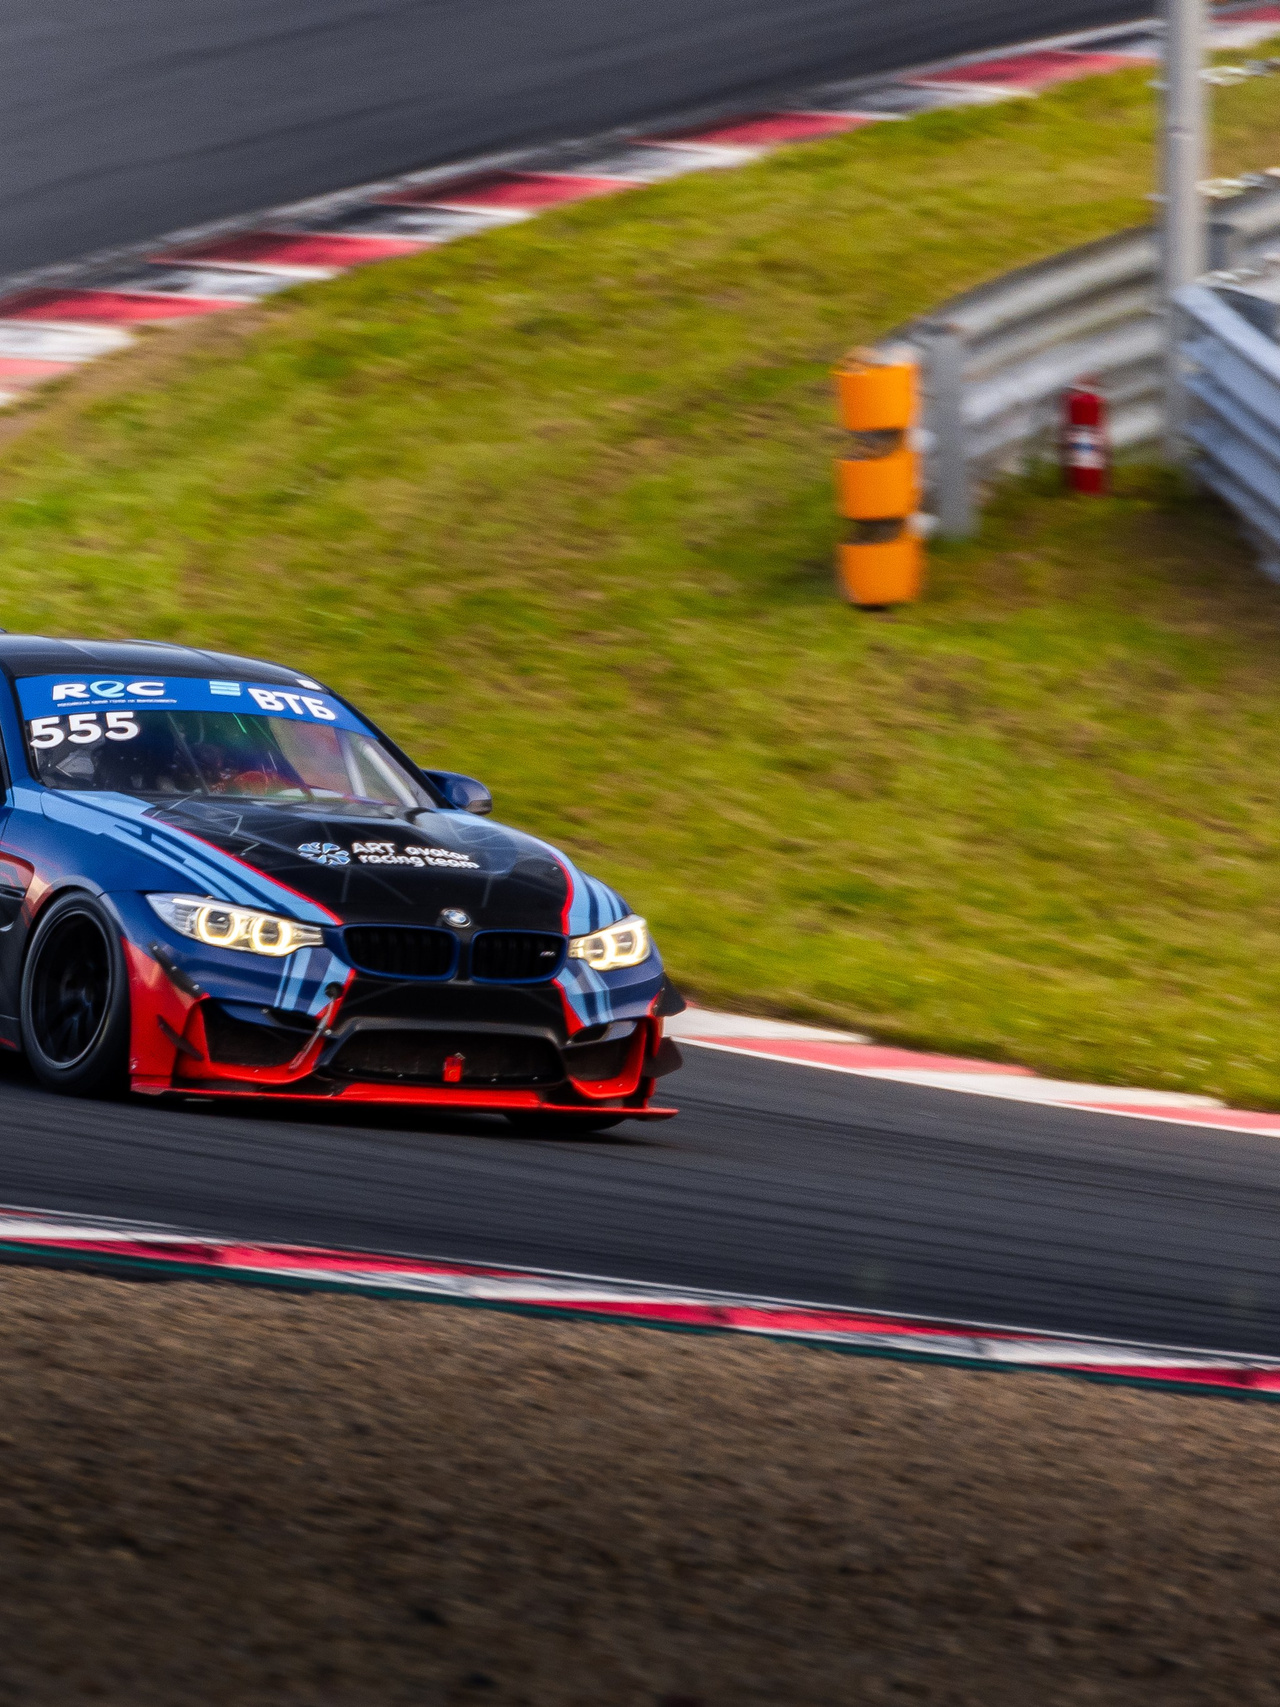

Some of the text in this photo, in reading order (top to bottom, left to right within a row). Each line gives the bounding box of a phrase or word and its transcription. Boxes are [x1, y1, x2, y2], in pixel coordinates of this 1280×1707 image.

[248, 688, 336, 720] ВТБ
[30, 711, 140, 749] 555
[351, 841, 470, 861] ART avatar
[358, 853, 480, 869] racing team
